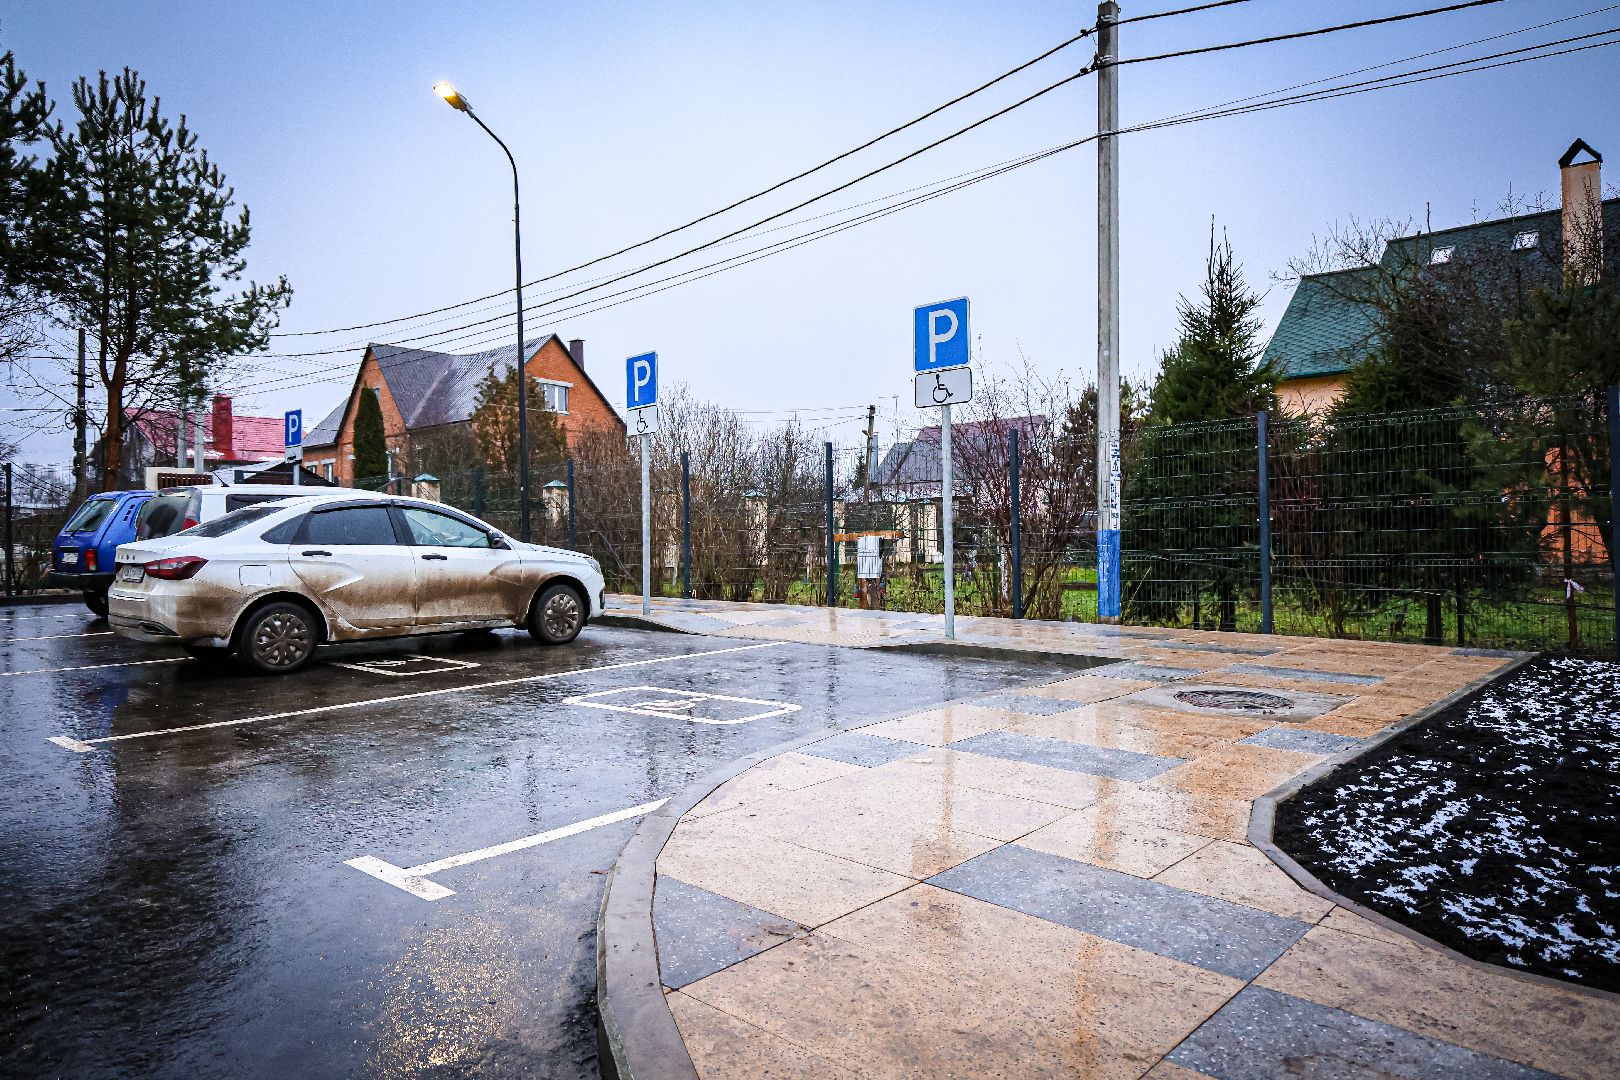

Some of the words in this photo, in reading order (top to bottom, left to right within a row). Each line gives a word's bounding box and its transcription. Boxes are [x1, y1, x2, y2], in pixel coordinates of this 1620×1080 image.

[929, 308, 958, 363] P
[634, 360, 651, 402] P
[289, 414, 299, 443] P
